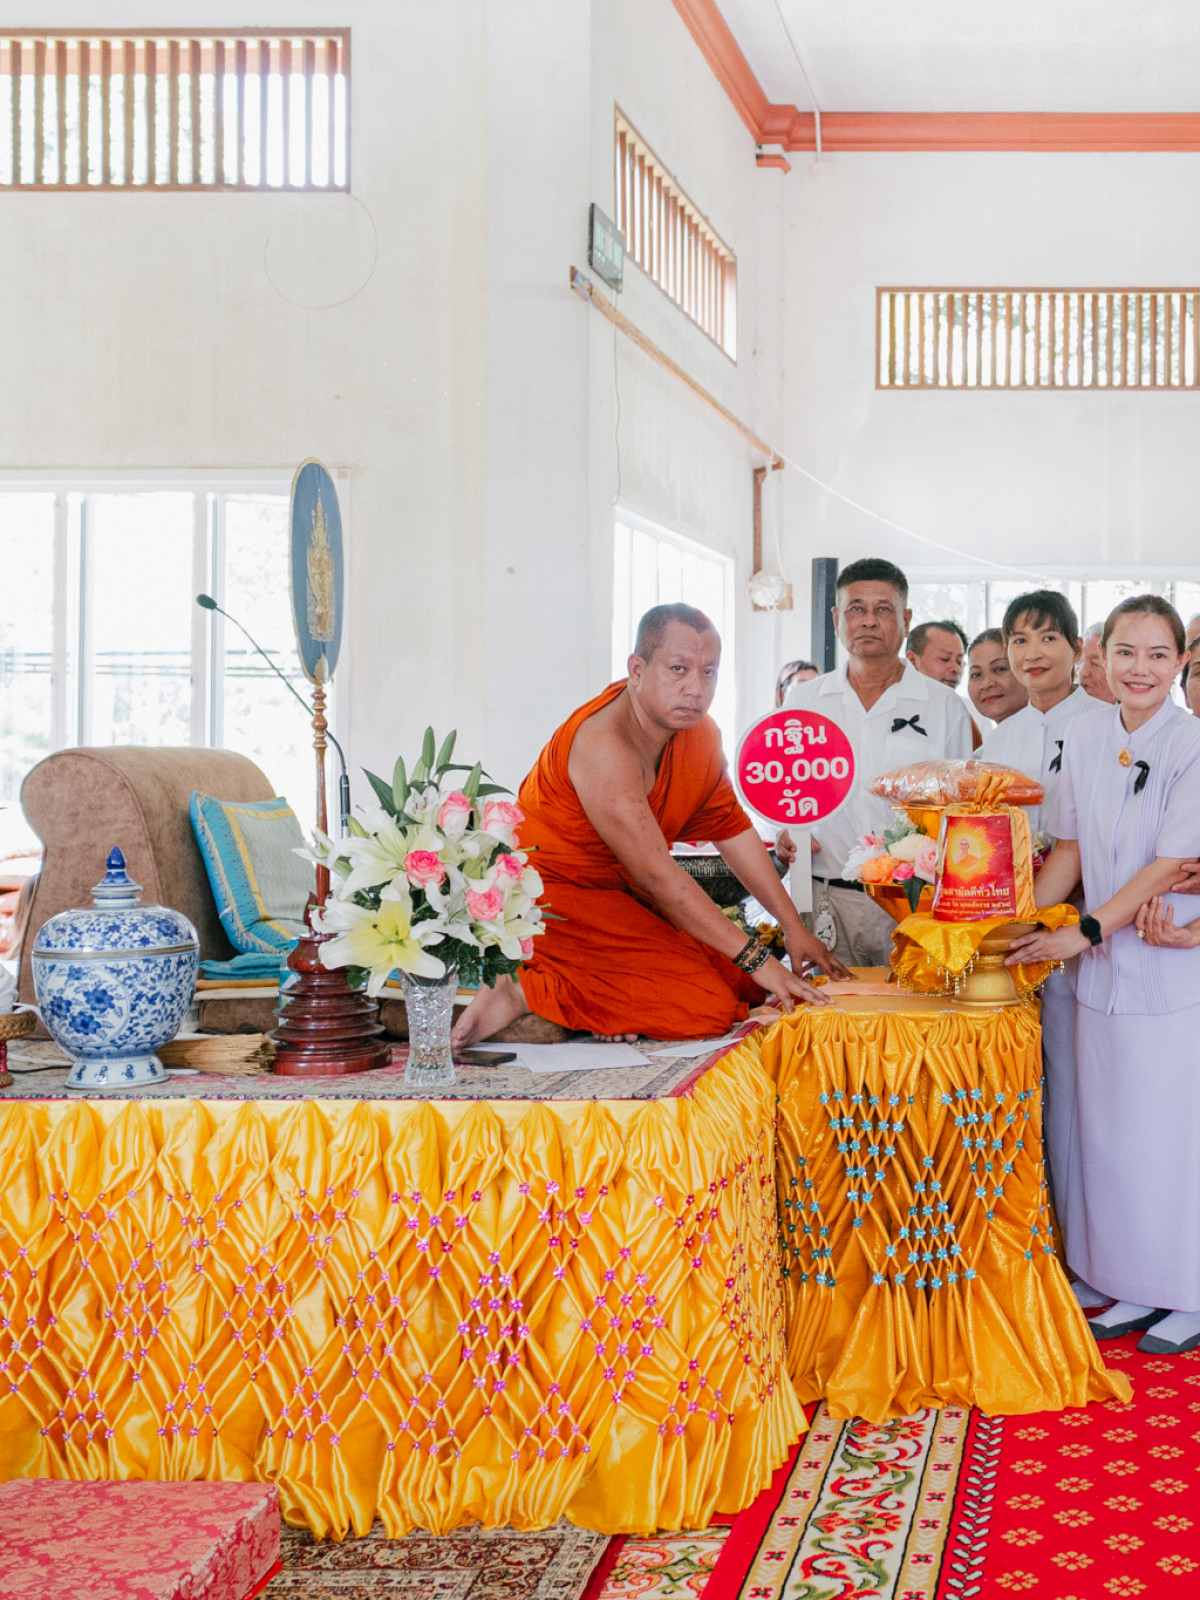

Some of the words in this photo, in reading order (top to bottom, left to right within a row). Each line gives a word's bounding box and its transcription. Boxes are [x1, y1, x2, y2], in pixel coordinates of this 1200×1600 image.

[764, 719, 827, 755] กฐิน
[745, 757, 849, 784] 30,000
[778, 789, 819, 817] วัด
